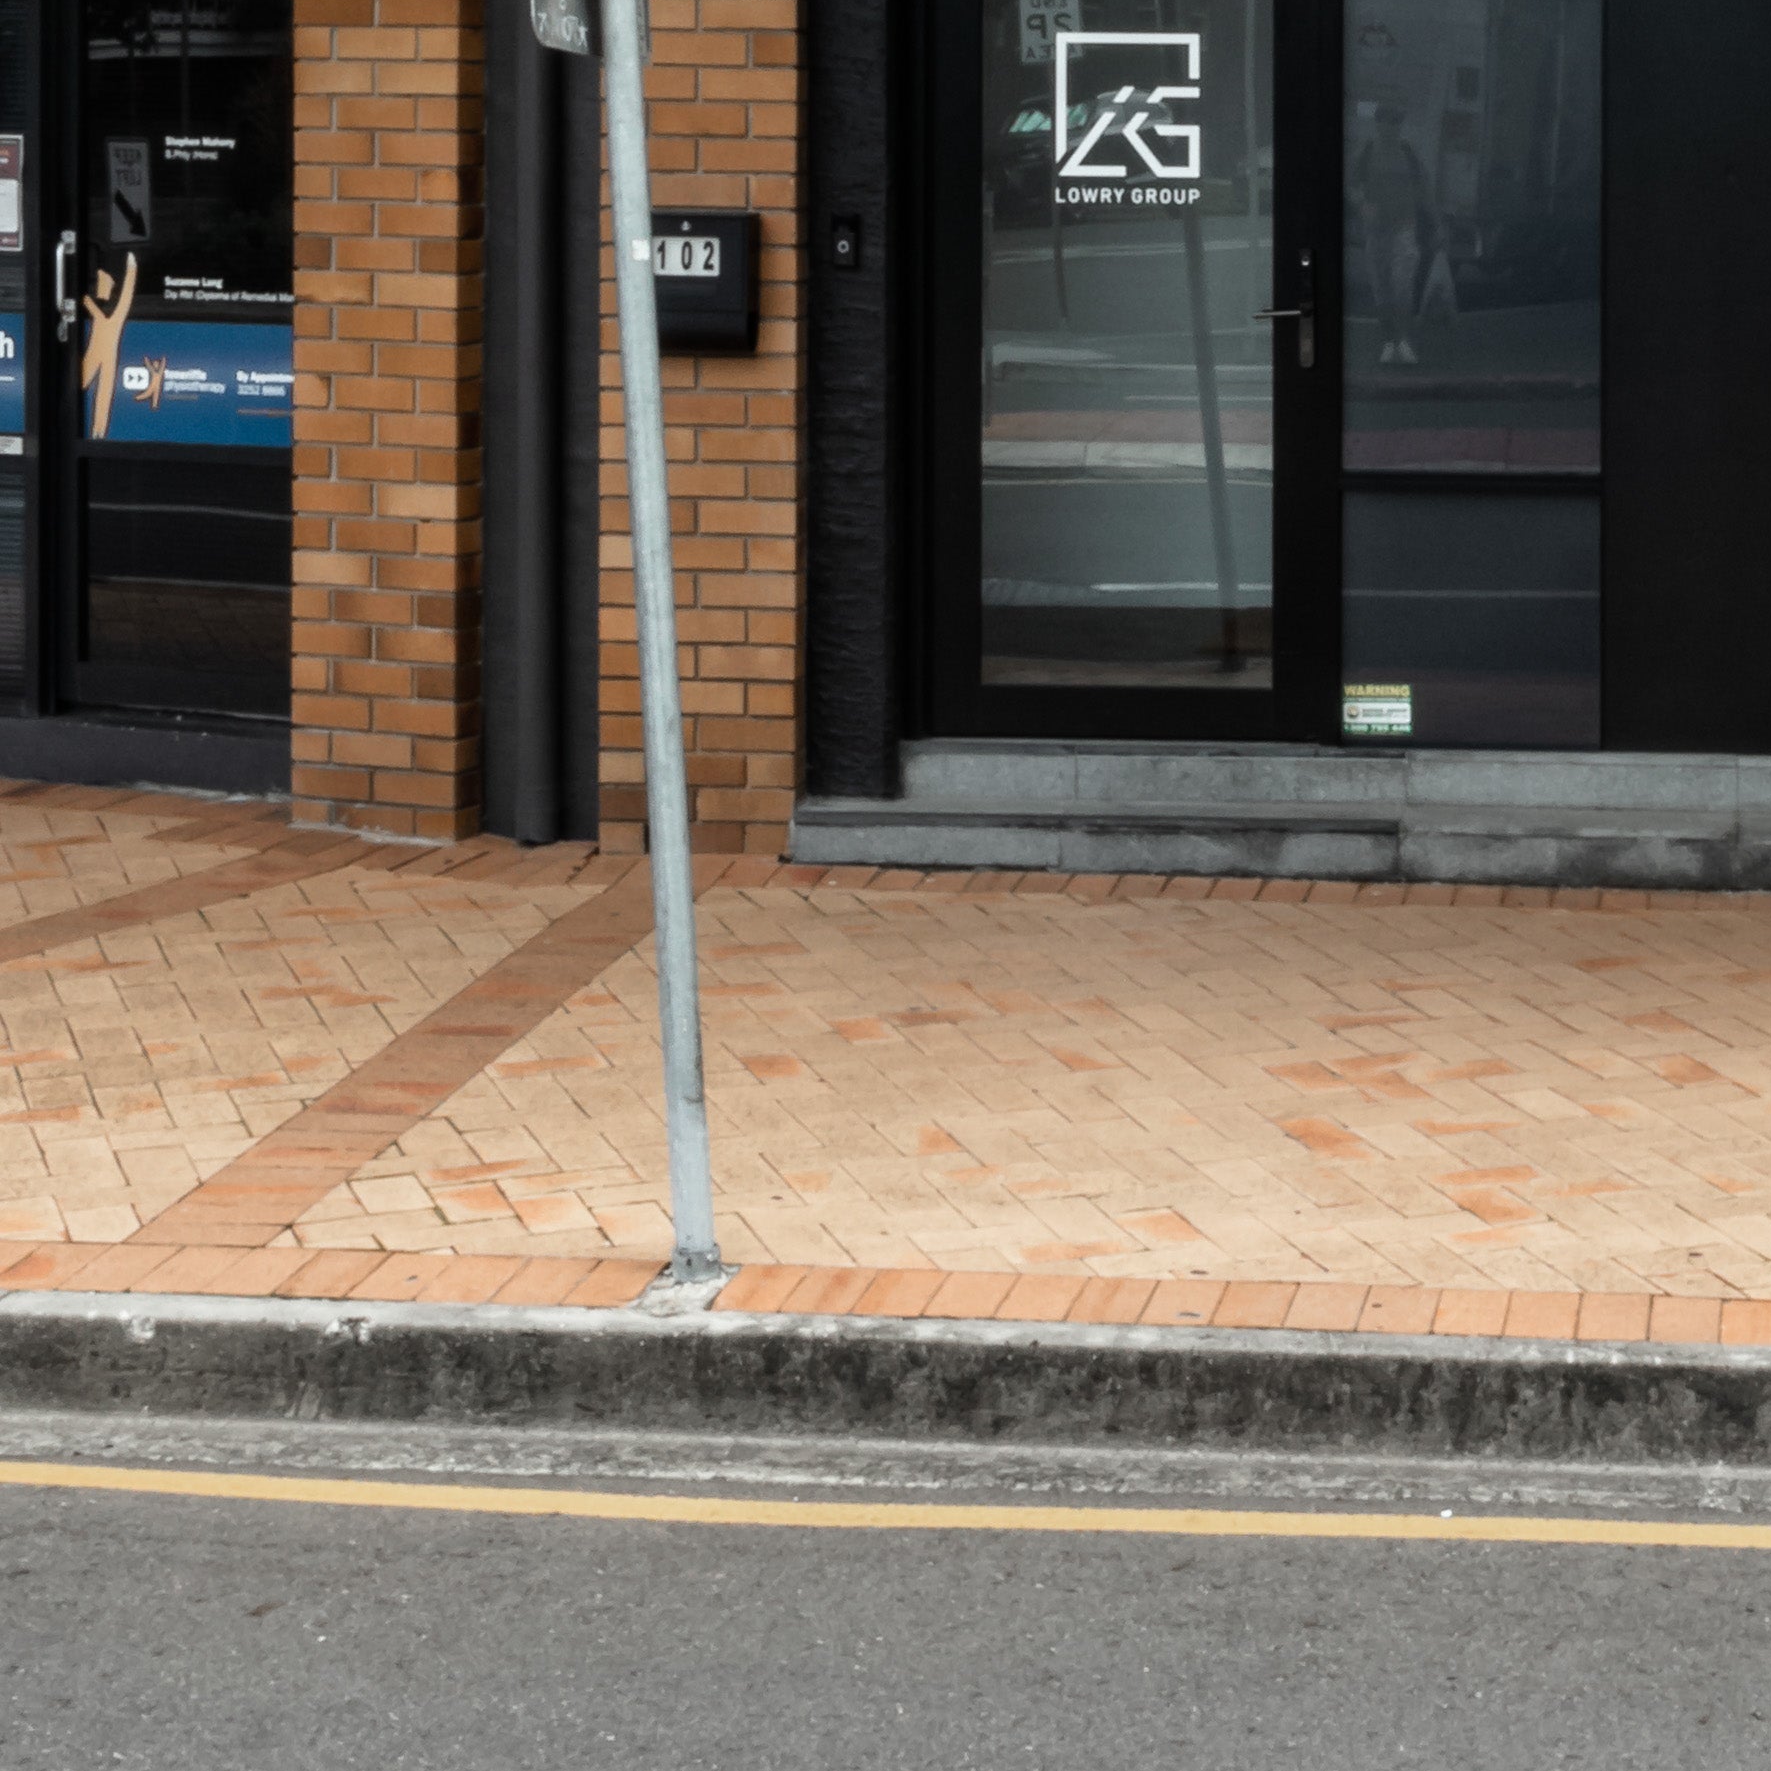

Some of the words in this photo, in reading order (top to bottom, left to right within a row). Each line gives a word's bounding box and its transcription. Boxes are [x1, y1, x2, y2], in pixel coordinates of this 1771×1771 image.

[1055, 187, 1125, 203] LOWRY
[1131, 188, 1201, 204] GROUP
[656, 240, 714, 270] 102
